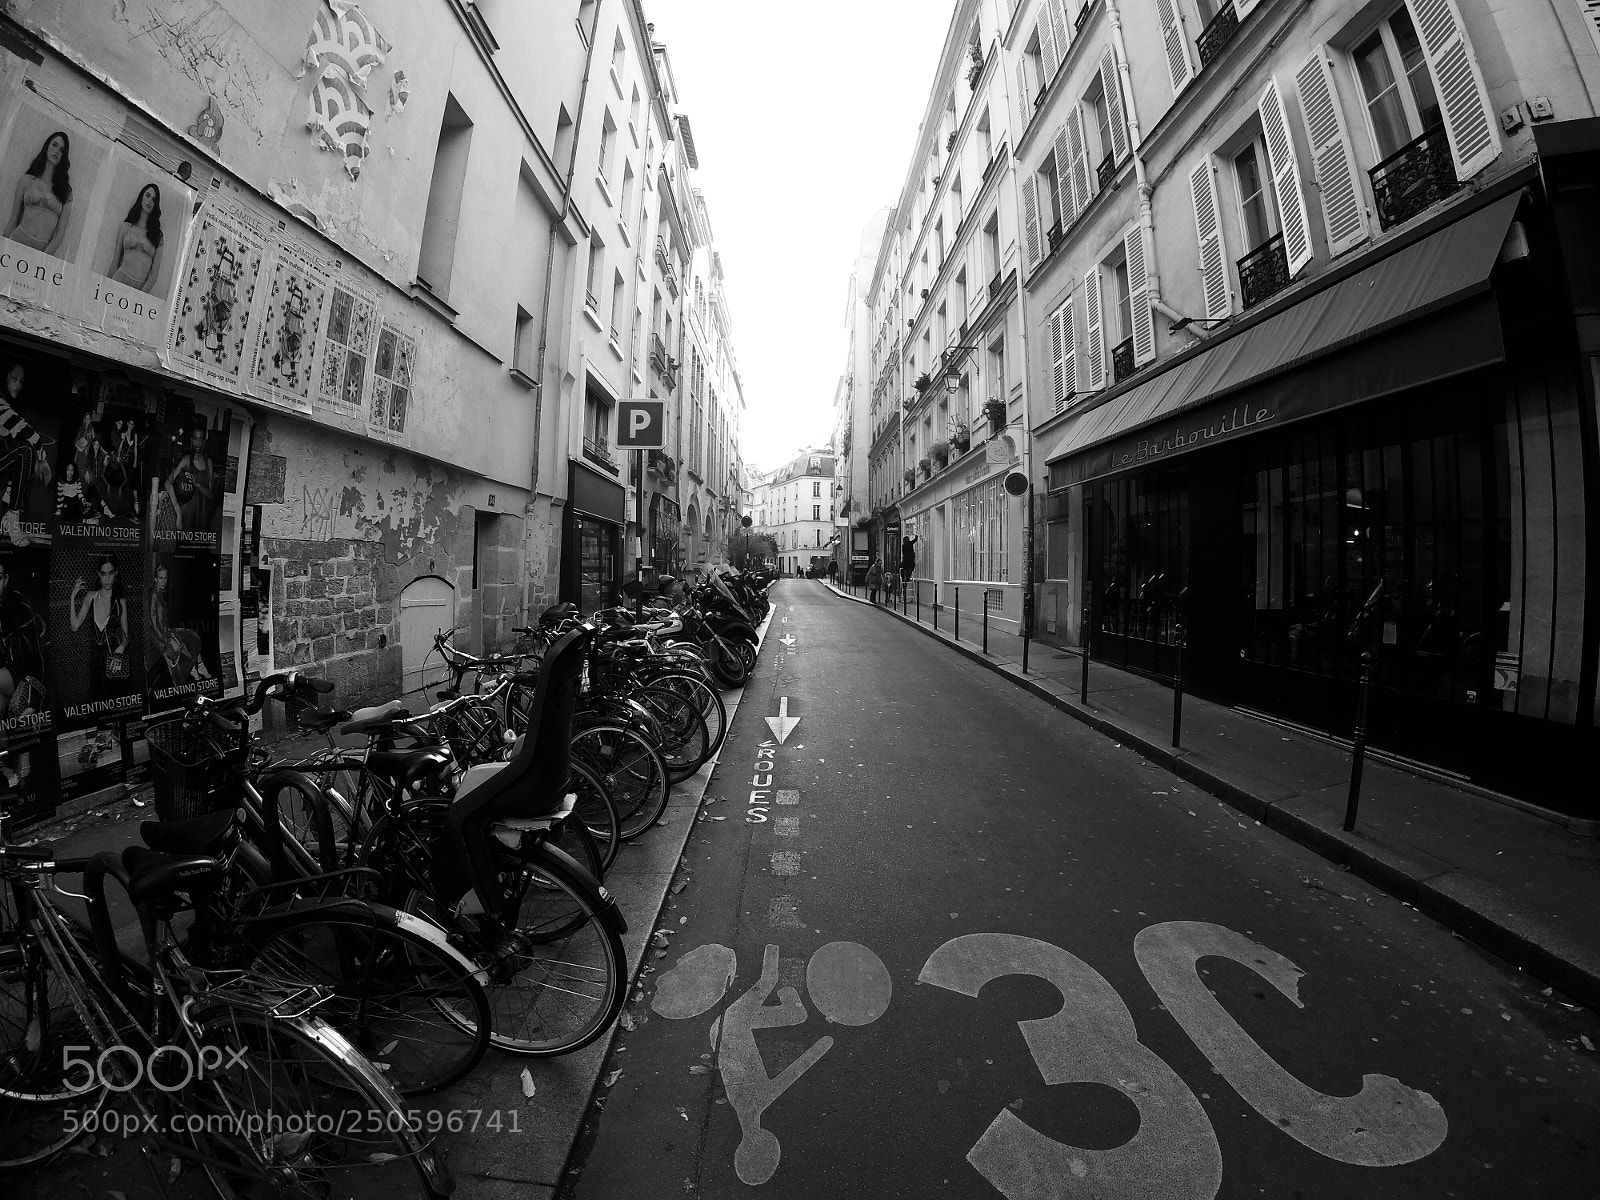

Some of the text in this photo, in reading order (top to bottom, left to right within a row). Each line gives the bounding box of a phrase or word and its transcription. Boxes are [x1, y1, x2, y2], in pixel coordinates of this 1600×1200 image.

[94, 283, 157, 320] icone
[629, 409, 651, 439] P
[1112, 404, 1276, 468] Le Barbouille
[13, 522, 47, 534] STORE
[59, 525, 141, 539] VALENTINO STORE
[152, 530, 217, 542] VALENTINO STORE
[154, 677, 219, 700] VALENTINO STORE
[64, 699, 115, 718] VALENTINO
[115, 693, 143, 708] STORE
[19, 710, 52, 727] STORE
